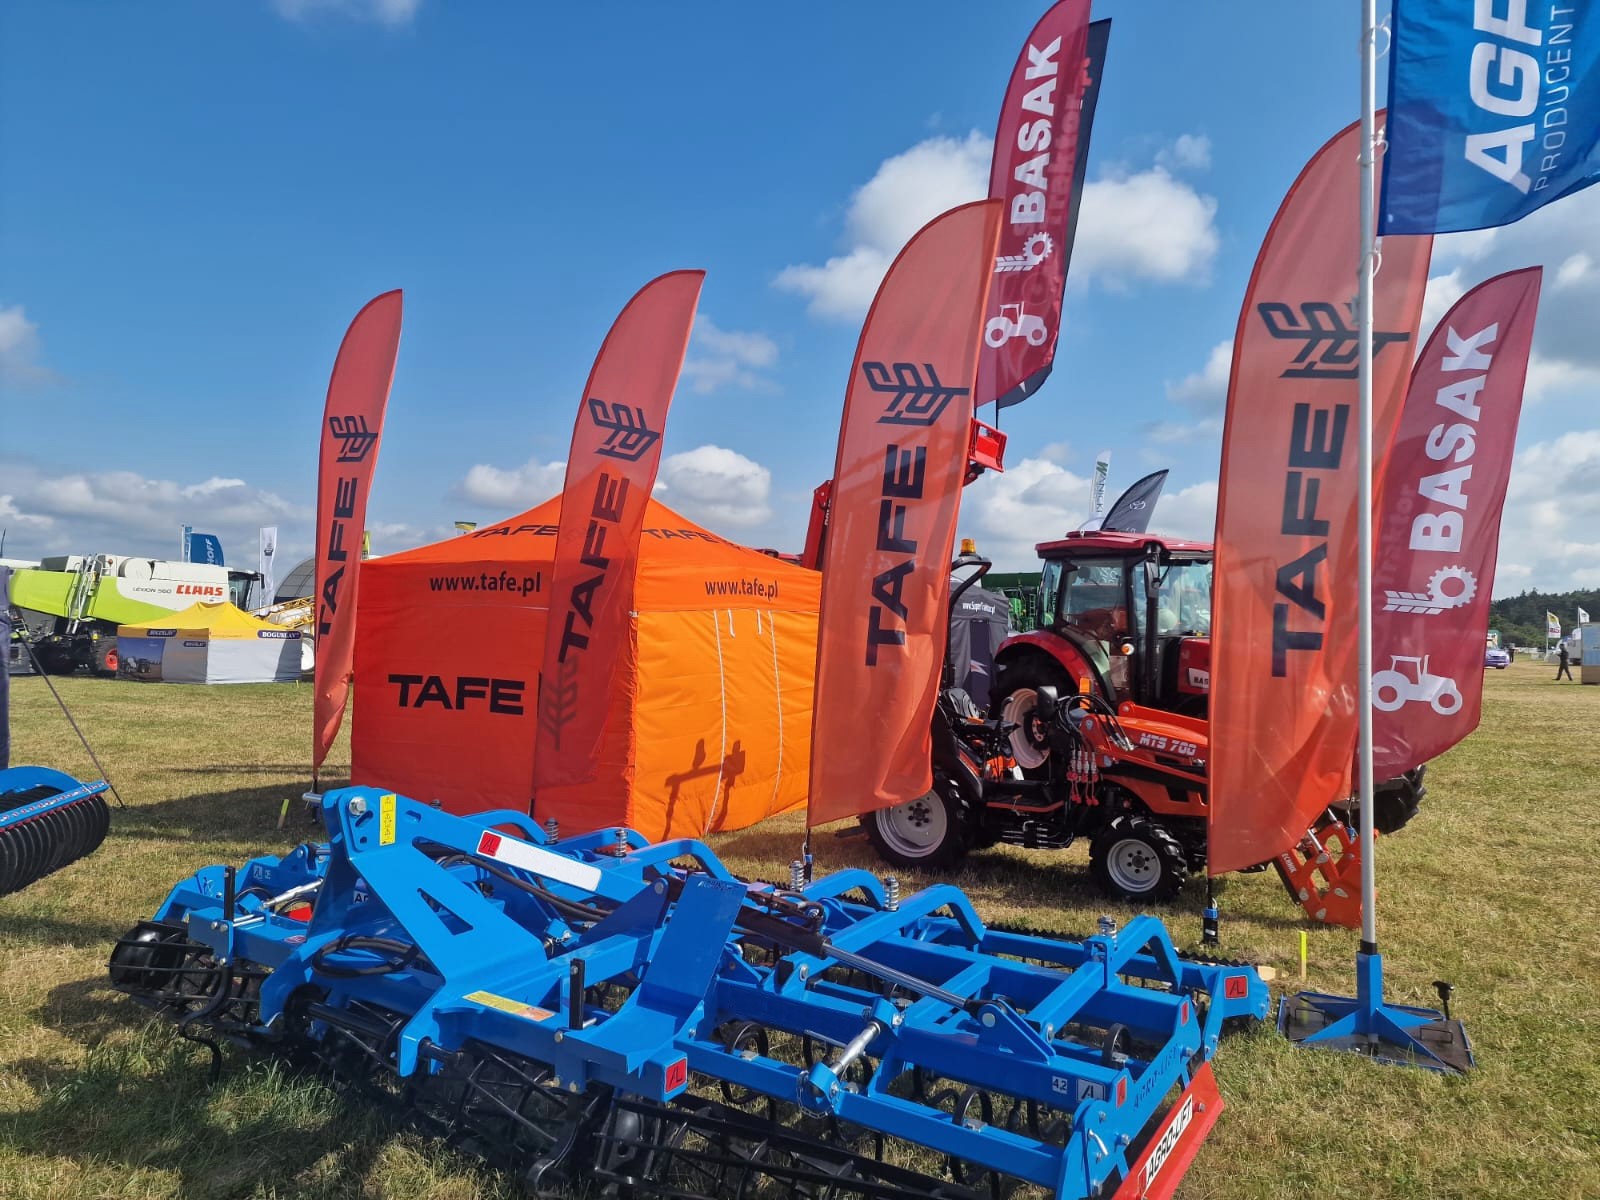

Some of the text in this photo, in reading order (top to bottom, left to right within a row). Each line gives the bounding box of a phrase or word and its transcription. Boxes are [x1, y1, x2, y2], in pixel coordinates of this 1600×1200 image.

[1010, 35, 1062, 225] BASAK
[1534, 5, 1575, 192] PRODUCENT
[1409, 322, 1499, 553] BASAK
[317, 477, 358, 653] TAFE
[430, 572, 541, 598] www.tafe.pl
[472, 524, 560, 539] TAFE
[558, 472, 630, 664] TAFE
[641, 528, 719, 544] TAFE
[865, 444, 927, 667] TAFE
[1272, 402, 1350, 678] TAFE
[176, 585, 224, 597] CLAAS
[705, 578, 779, 602] www.tafe.pl
[388, 673, 525, 716] TAFE
[1140, 733, 1197, 756] MTS 700
